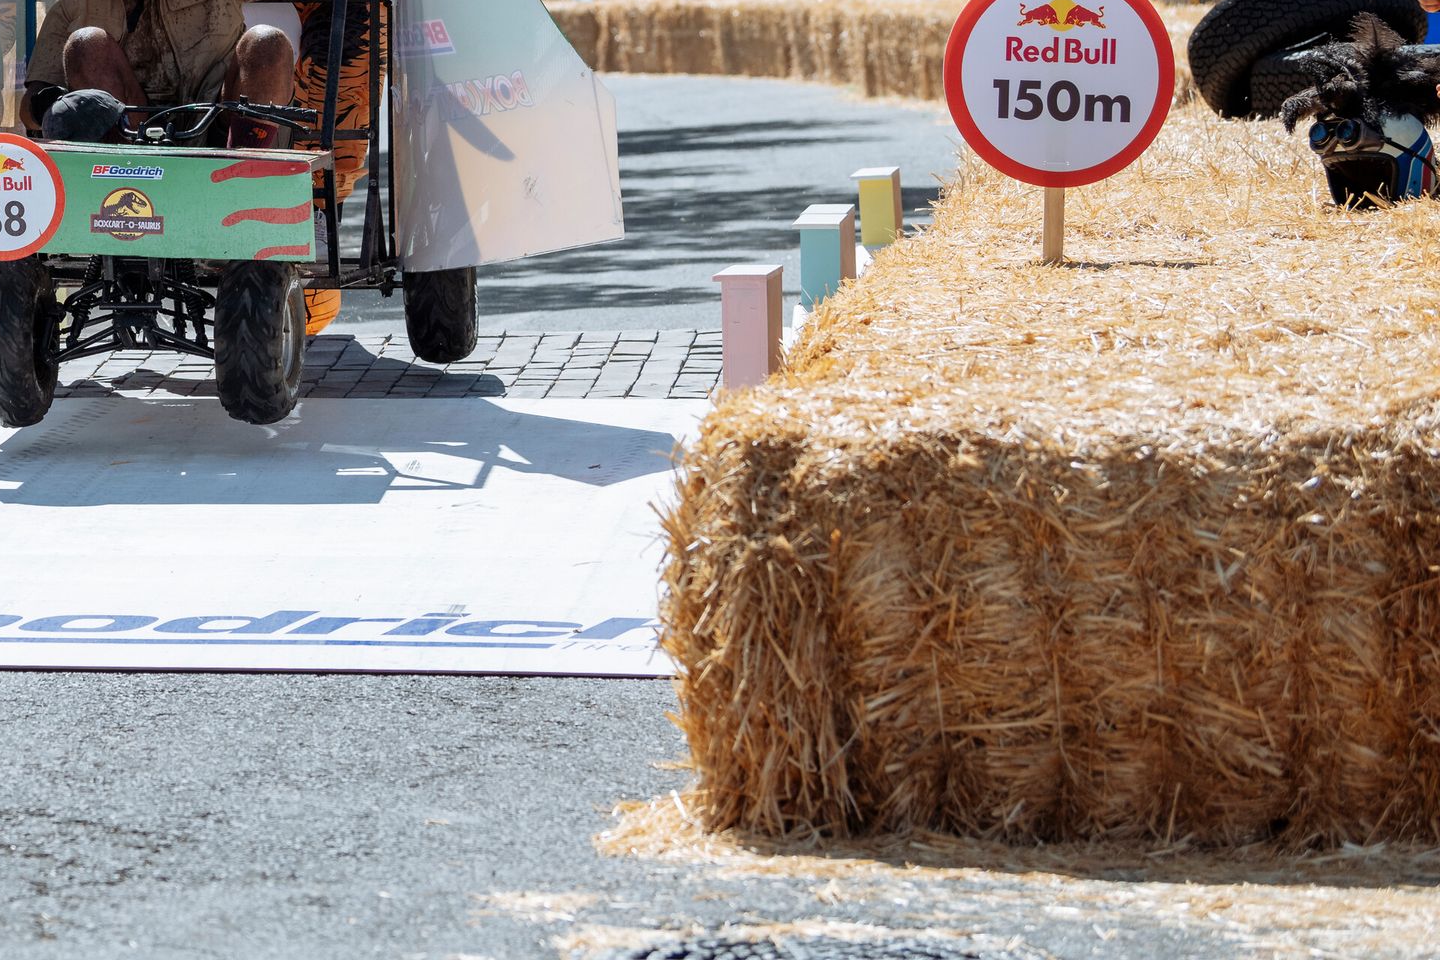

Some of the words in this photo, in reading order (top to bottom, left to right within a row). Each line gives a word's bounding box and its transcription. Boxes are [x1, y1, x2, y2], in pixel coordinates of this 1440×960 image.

[1005, 36, 1060, 64] Red
[1064, 38, 1117, 65] Bull
[992, 78, 1131, 123] 150m
[92, 165, 163, 176] BFGoodrich
[3, 175, 32, 191] Bull
[93, 219, 162, 231] BOXCART-O-SAURUS
